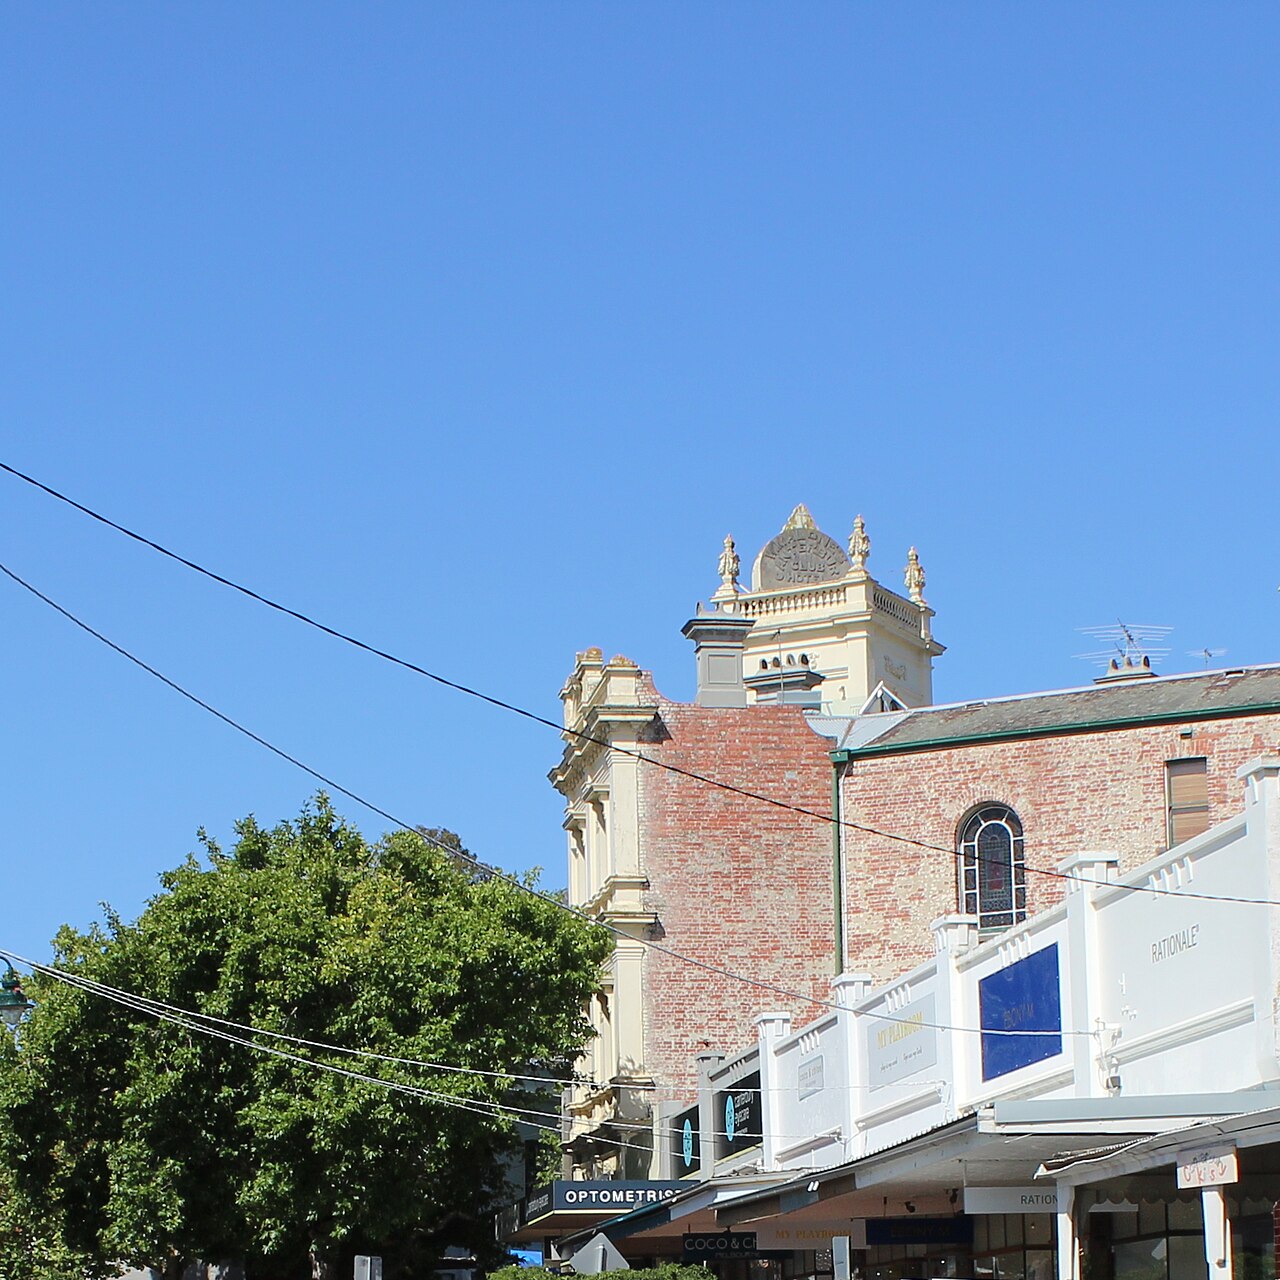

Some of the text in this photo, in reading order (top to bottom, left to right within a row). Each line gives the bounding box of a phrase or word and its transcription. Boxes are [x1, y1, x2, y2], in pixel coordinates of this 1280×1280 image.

[792, 561, 825, 573] CLUB
[684, 1237, 728, 1251] COCO
[730, 1237, 740, 1249] &
